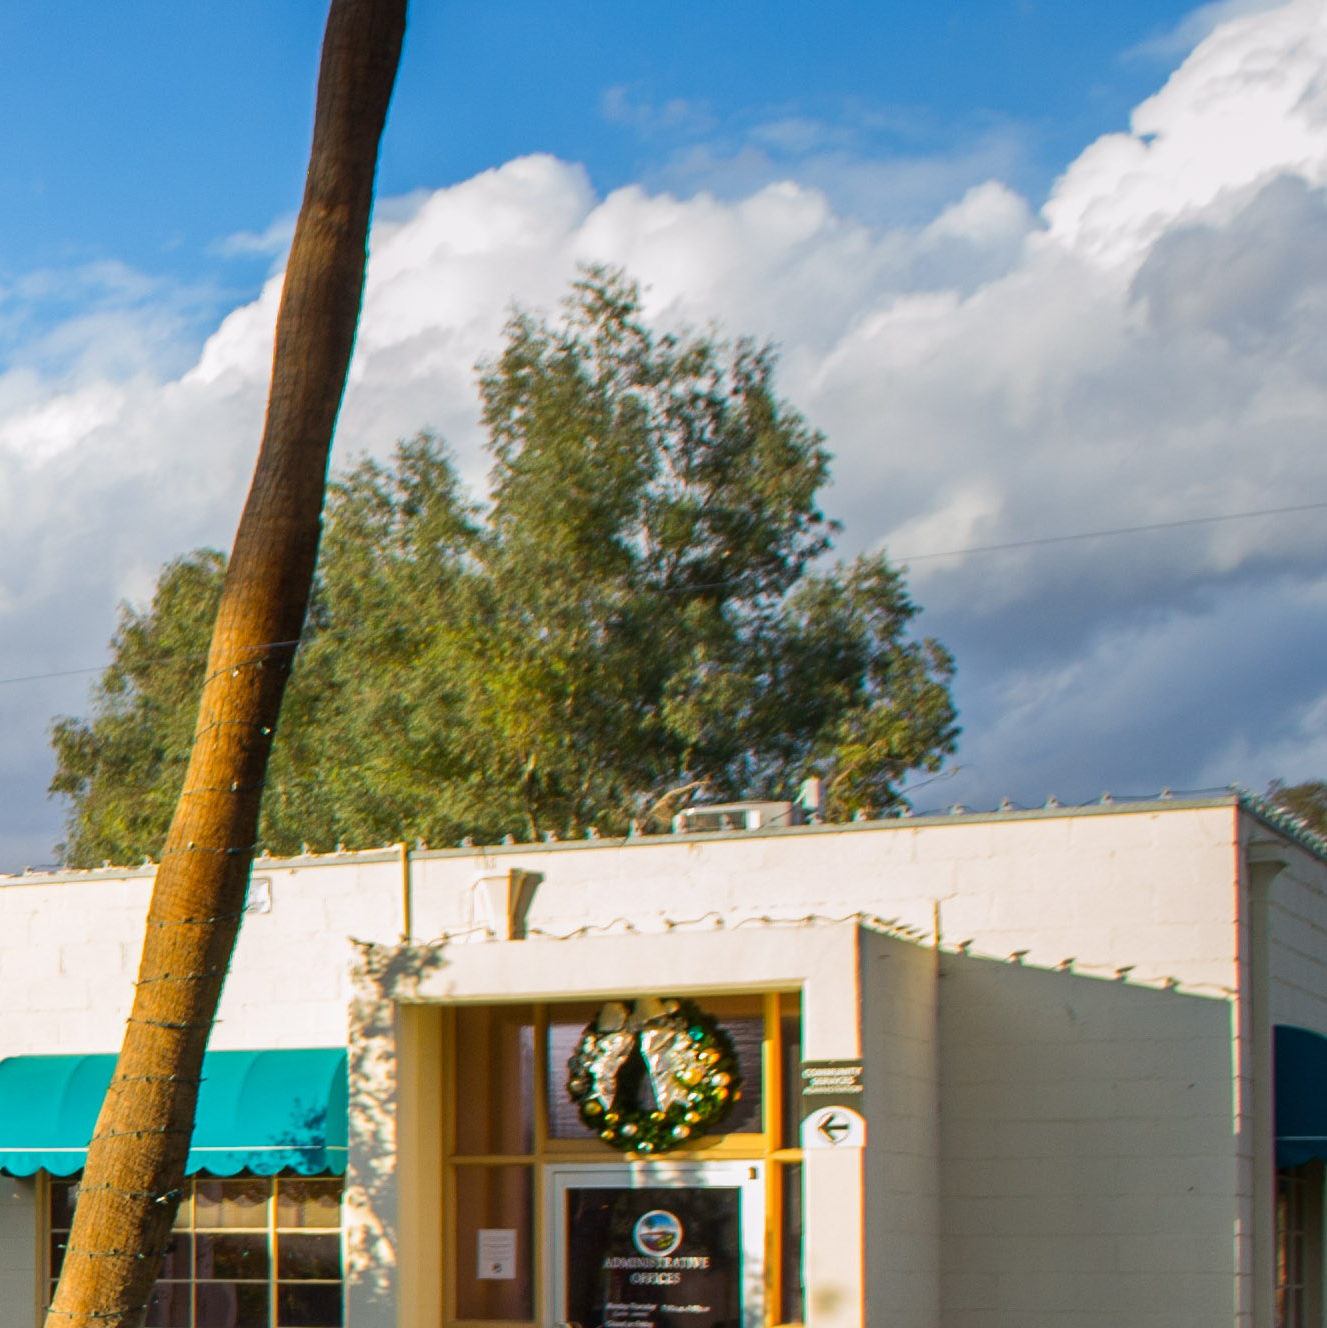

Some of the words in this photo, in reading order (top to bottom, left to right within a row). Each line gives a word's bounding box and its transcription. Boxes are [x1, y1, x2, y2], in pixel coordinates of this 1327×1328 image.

[802, 1066, 863, 1079] COMMUNITY
[604, 1256, 711, 1270] ADMINISTRATIVE
[629, 1271, 682, 1285] OFFICES
